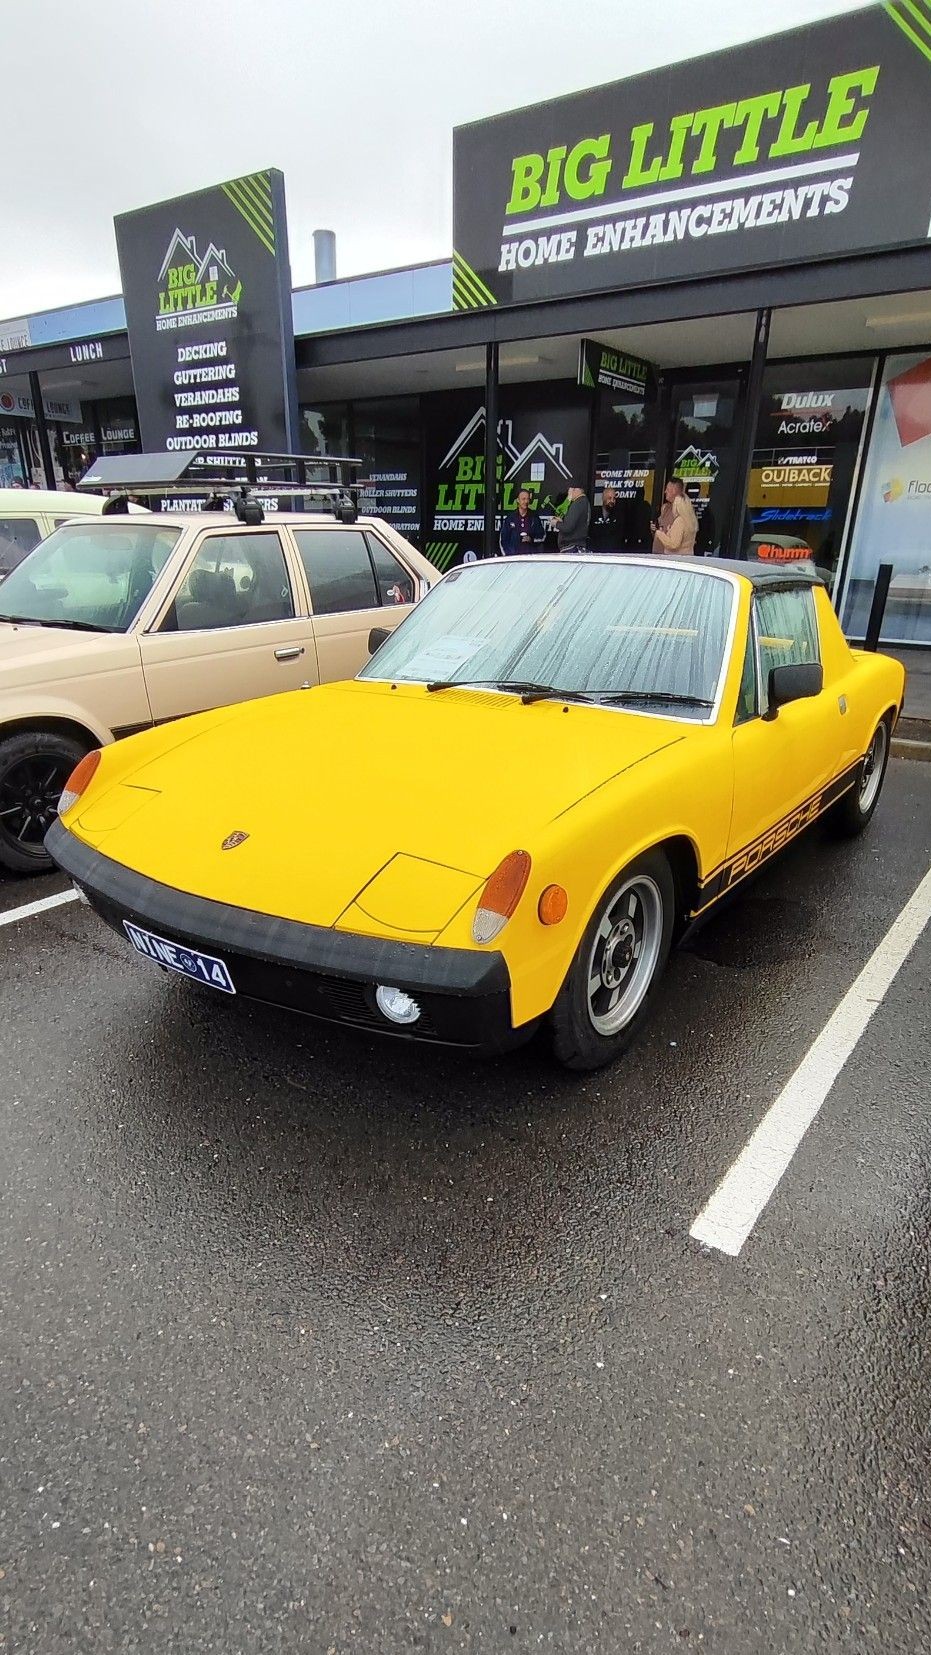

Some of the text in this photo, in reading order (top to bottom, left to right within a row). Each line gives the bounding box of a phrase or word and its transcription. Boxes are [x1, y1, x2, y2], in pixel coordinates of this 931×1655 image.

[506, 65, 880, 215] BIG LITTLE
[498, 177, 853, 272] HOME ENHANCEMENTS
[168, 263, 196, 289] BIG
[159, 281, 217, 315] LITTLE
[156, 306, 238, 331] HOME ENHANCEMENTS
[69, 342, 103, 362] LUNCH
[177, 341, 227, 362] DECKING
[173, 364, 236, 385] GUTTERING
[600, 351, 648, 380] BIG LITTLE
[174, 387, 240, 407] VERANDAHS
[781, 392, 835, 410] Dulux
[63, 427, 135, 444] COFFEE LOUNGE
[777, 420, 833, 435] Acratex
[166, 431, 258, 451] OUTDOOR BLINDS
[681, 459, 697, 467] BIG
[783, 455, 818, 465] STRATCO
[600, 469, 650, 478] COME IN AND
[762, 465, 833, 482] OUTBACK
[385, 489, 417, 497] SHUTTERS
[604, 480, 645, 488] TALK TO US
[161, 499, 207, 512] PLANTAT
[435, 482, 541, 511] LITLE
[362, 505, 416, 514] OUTDOOR BLINDS
[433, 519, 465, 531] HOME
[770, 545, 811, 560] humm
[728, 794, 822, 885] PORSCHE
[129, 928, 227, 987] NINE 14
